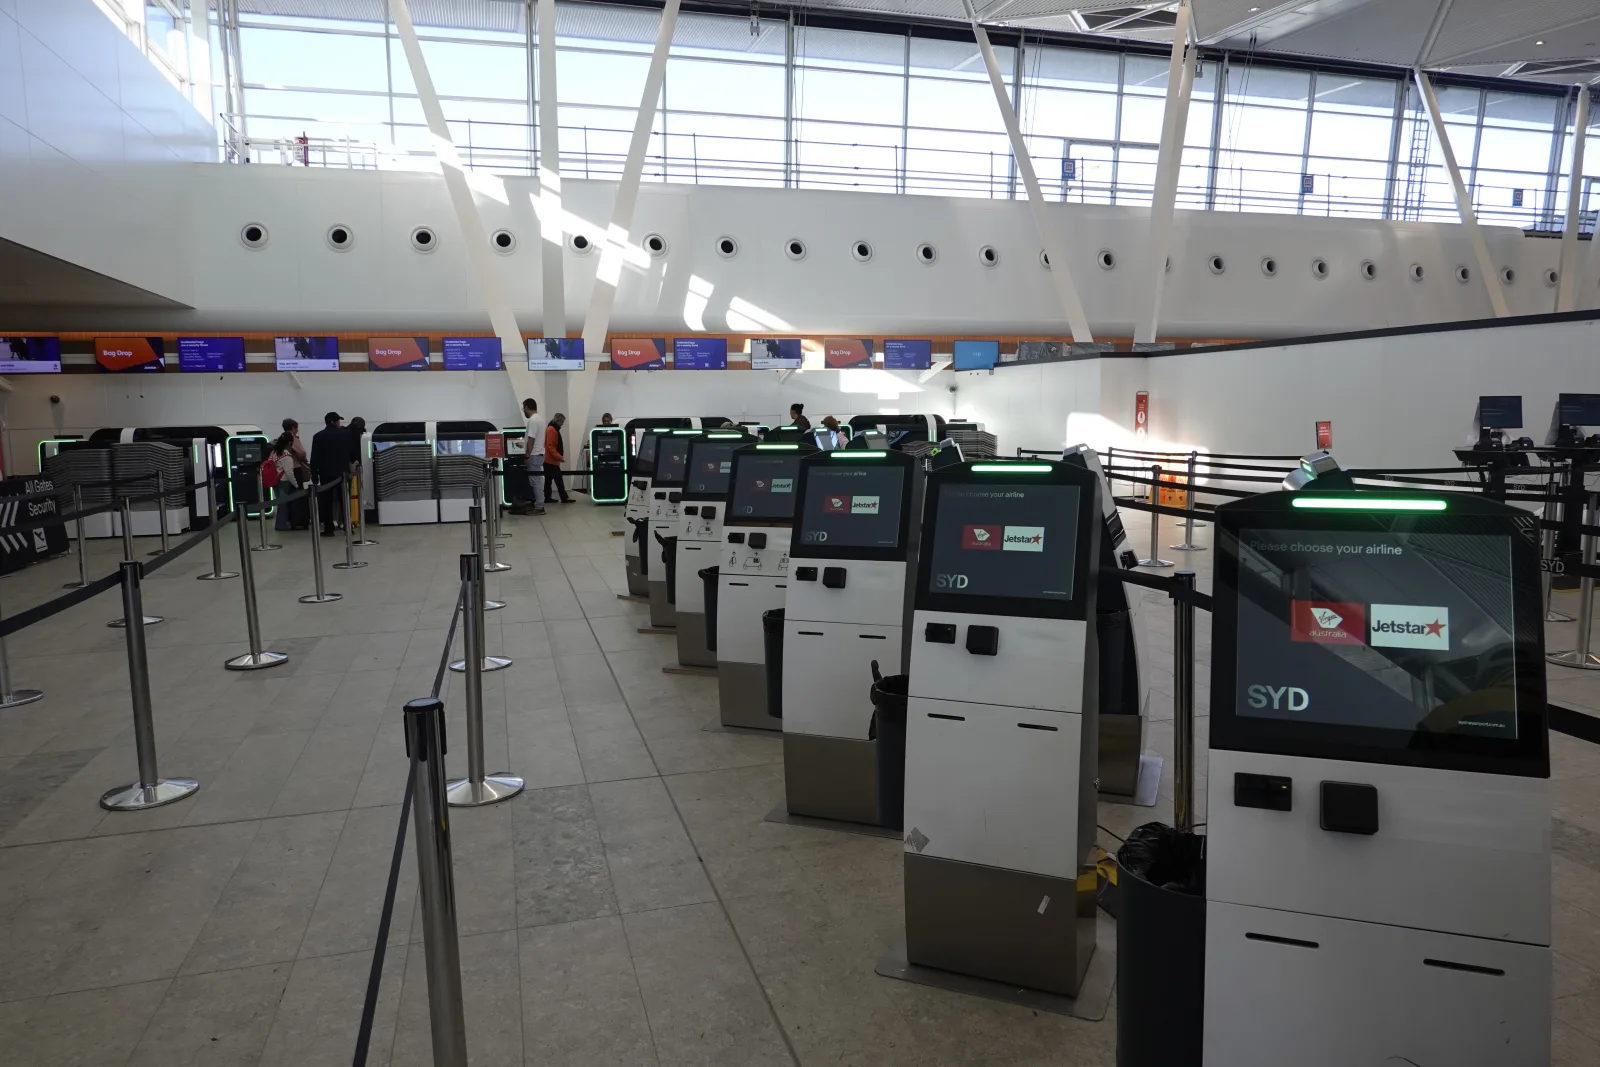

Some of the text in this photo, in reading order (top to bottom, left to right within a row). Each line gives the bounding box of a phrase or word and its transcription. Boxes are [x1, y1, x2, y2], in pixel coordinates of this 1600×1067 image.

[25, 479, 54, 494] All Gates
[28, 498, 56, 516] Security
[805, 531, 828, 542] SYD
[1004, 534, 1033, 544] Jetstar
[1250, 540, 1403, 556] Please choose your airline
[1540, 559, 1565, 573] SYD
[935, 573, 969, 589] SYD
[1318, 611, 1338, 626] Virgin
[1309, 630, 1348, 639] australia
[1372, 619, 1426, 635] Jetstar
[1247, 684, 1310, 712] SYD
